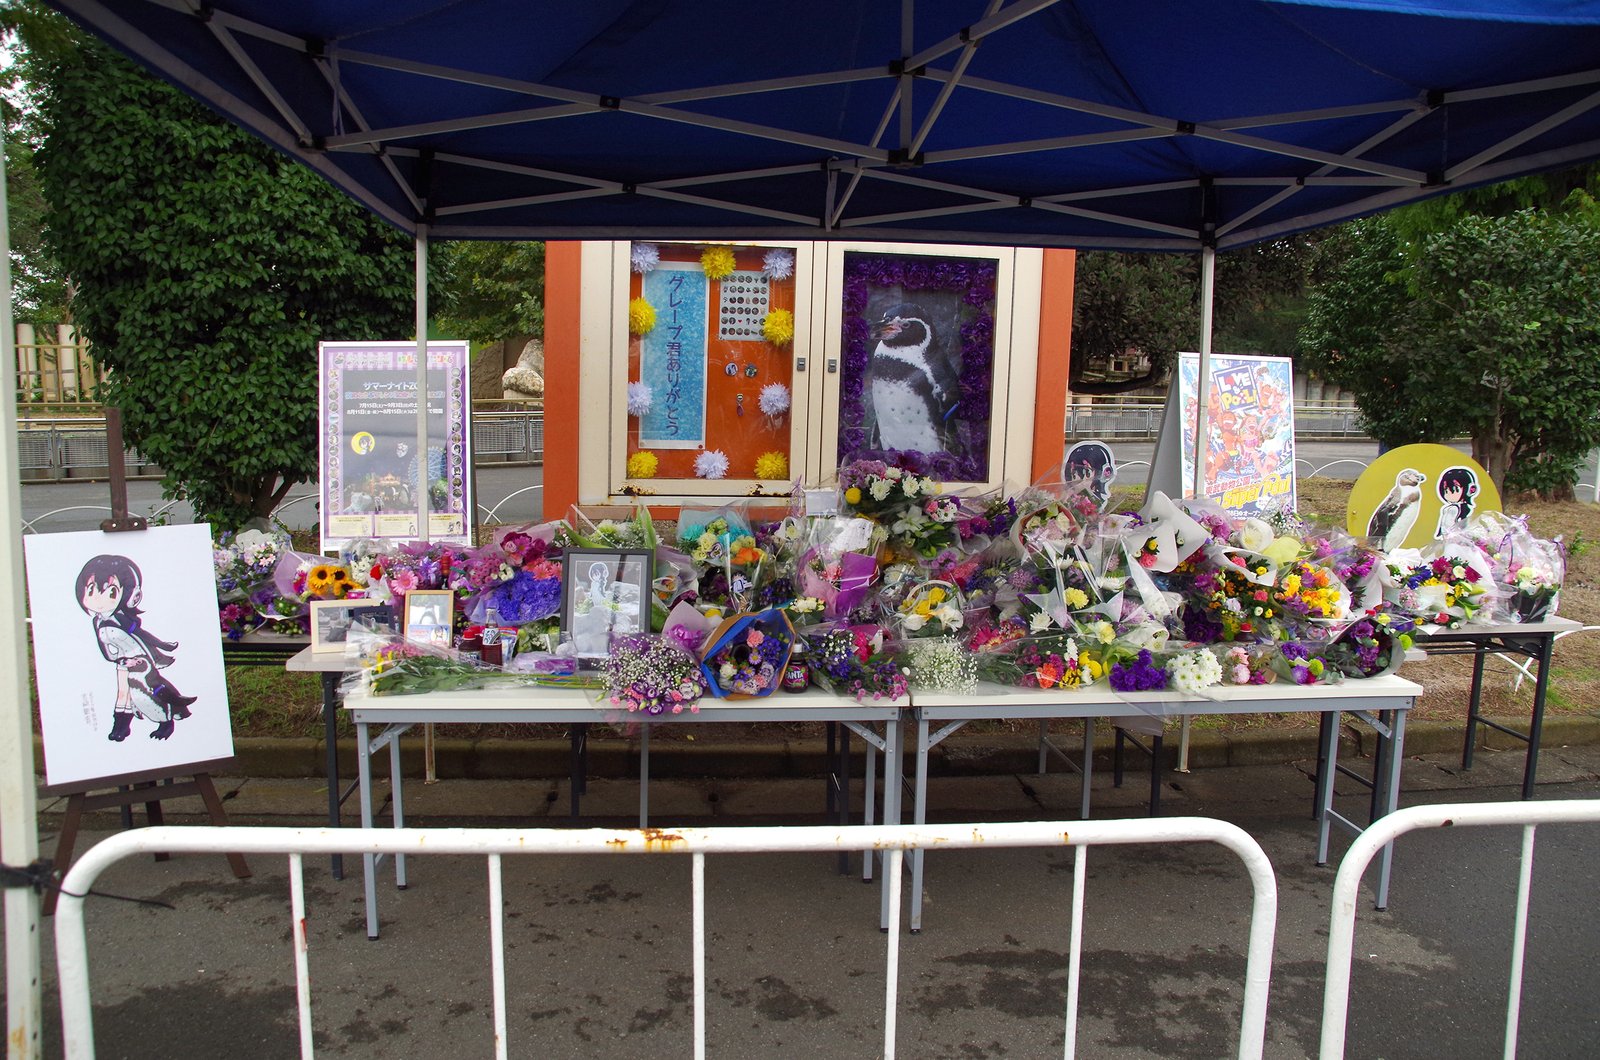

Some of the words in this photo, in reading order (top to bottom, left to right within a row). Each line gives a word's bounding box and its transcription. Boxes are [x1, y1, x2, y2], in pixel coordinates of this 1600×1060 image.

[665, 275, 683, 437] グレープ君ありがとう
[1218, 372, 1251, 393] LOVE
